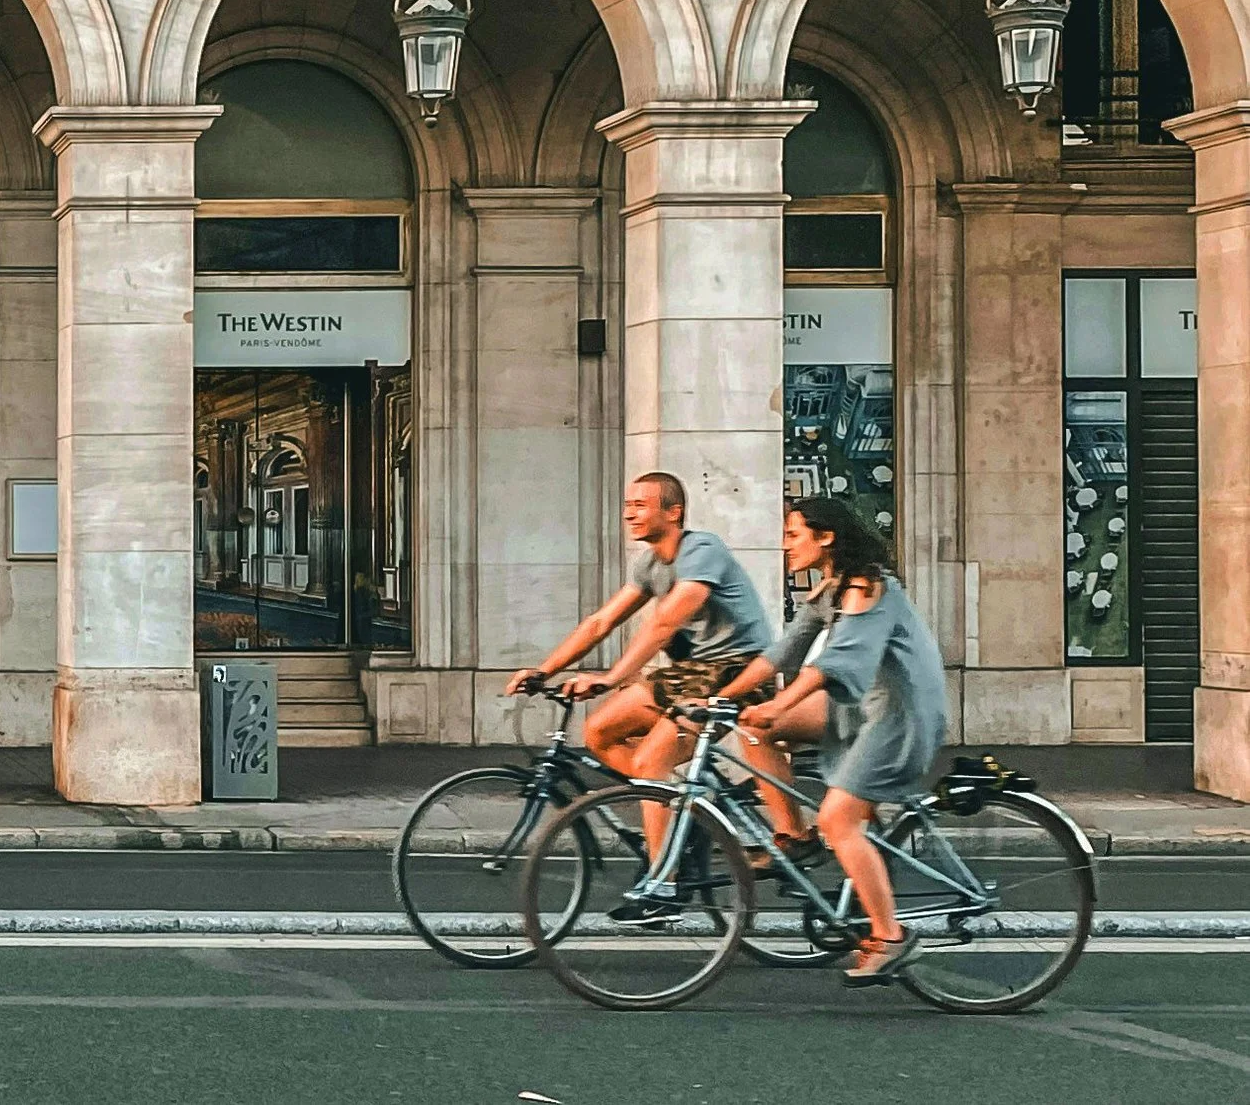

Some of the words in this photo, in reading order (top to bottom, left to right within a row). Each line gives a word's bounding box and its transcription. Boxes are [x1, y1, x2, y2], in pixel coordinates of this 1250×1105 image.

[217, 313, 258, 332] THE
[259, 313, 342, 332] WESTIN
[1178, 310, 1198, 330] T
[240, 337, 322, 348] PARIS-VENDÔME
